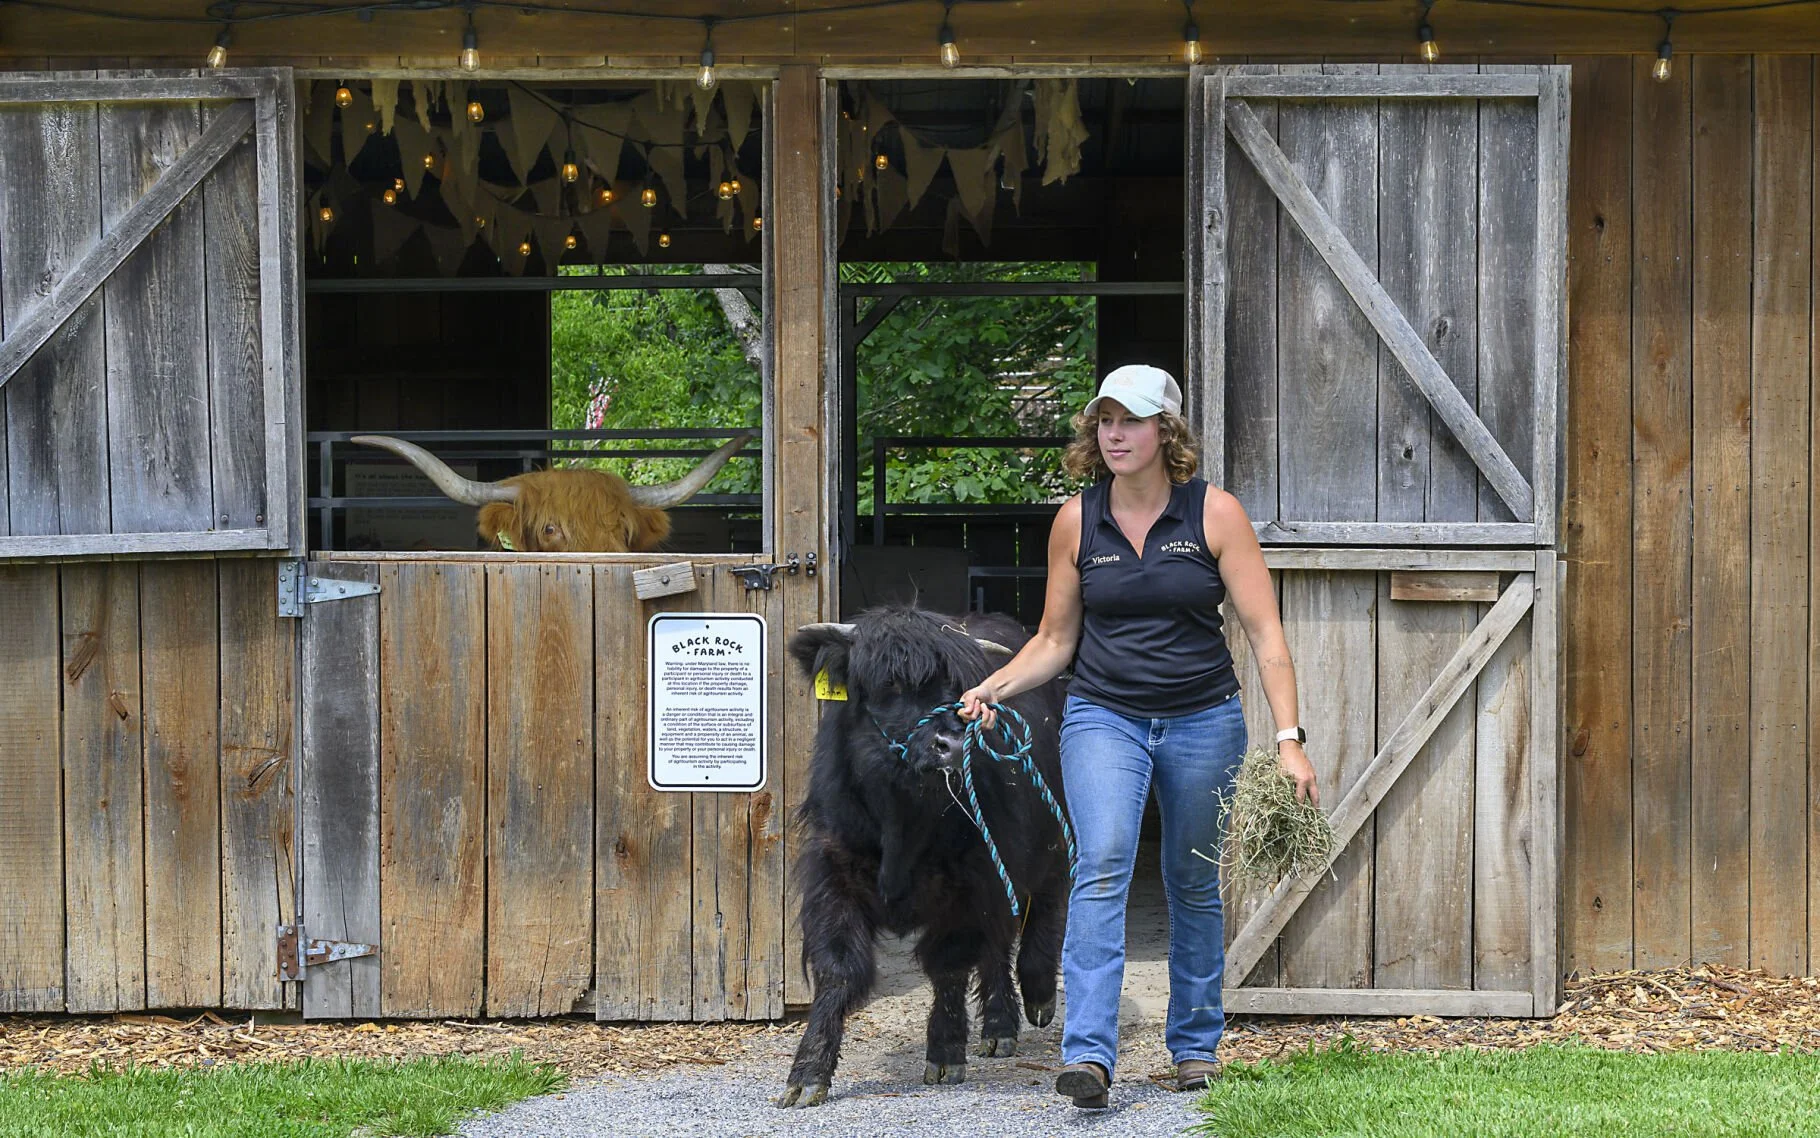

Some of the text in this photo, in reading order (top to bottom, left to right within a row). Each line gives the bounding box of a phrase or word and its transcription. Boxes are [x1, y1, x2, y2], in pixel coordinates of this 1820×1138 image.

[1161, 541, 1200, 552] BLACK ROCK
[1092, 554, 1120, 564] Victoria
[672, 637, 743, 653] BLACK ROCK
